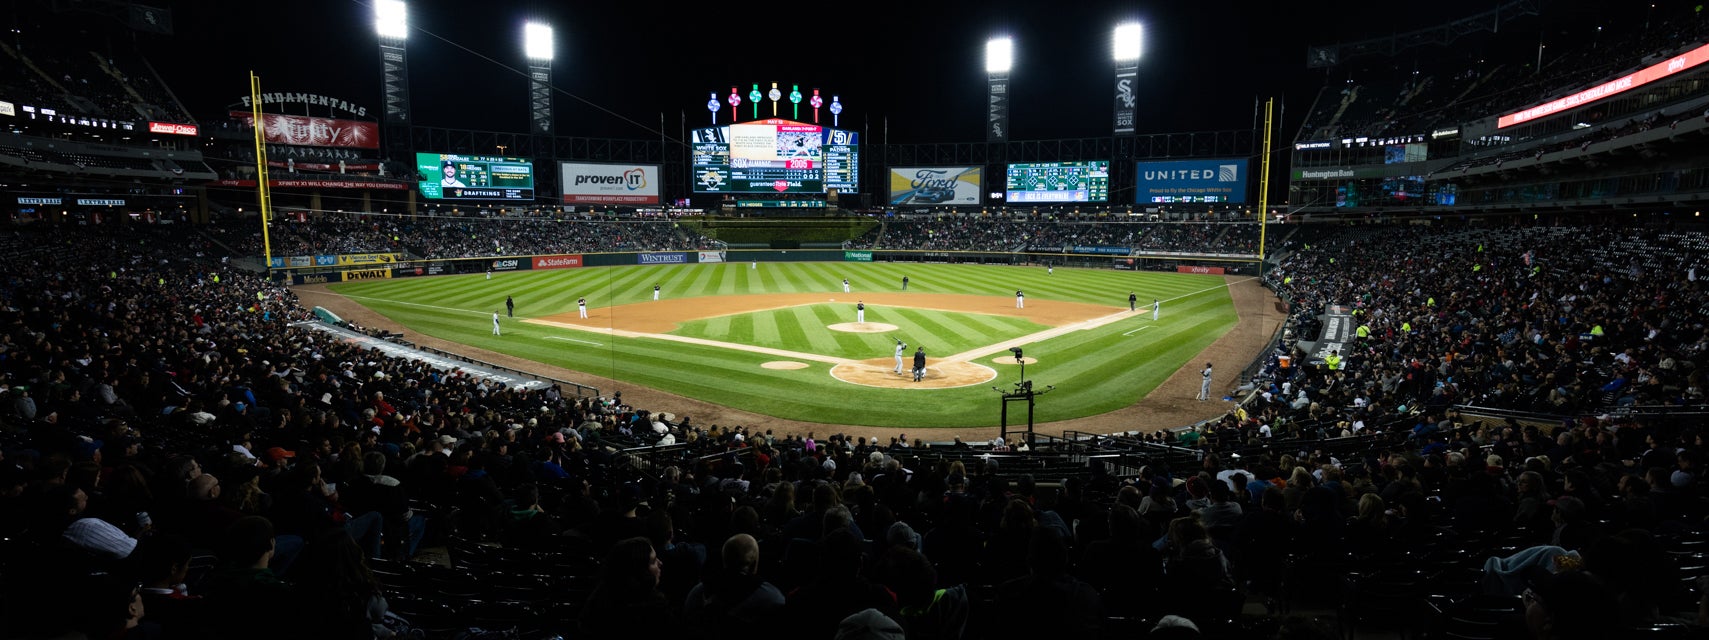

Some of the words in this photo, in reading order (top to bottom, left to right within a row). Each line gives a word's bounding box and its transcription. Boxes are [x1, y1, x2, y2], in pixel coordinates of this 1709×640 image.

[154, 122, 197, 135] Jewel-Osco
[733, 158, 747, 168] SOX
[790, 160, 808, 168] 2005
[575, 174, 624, 186] proven
[630, 174, 641, 185] IT
[910, 169, 960, 189] Ford
[1144, 170, 1214, 180] UNITED
[1302, 170, 1338, 179] Huntington
[641, 253, 682, 264] WINTRUST
